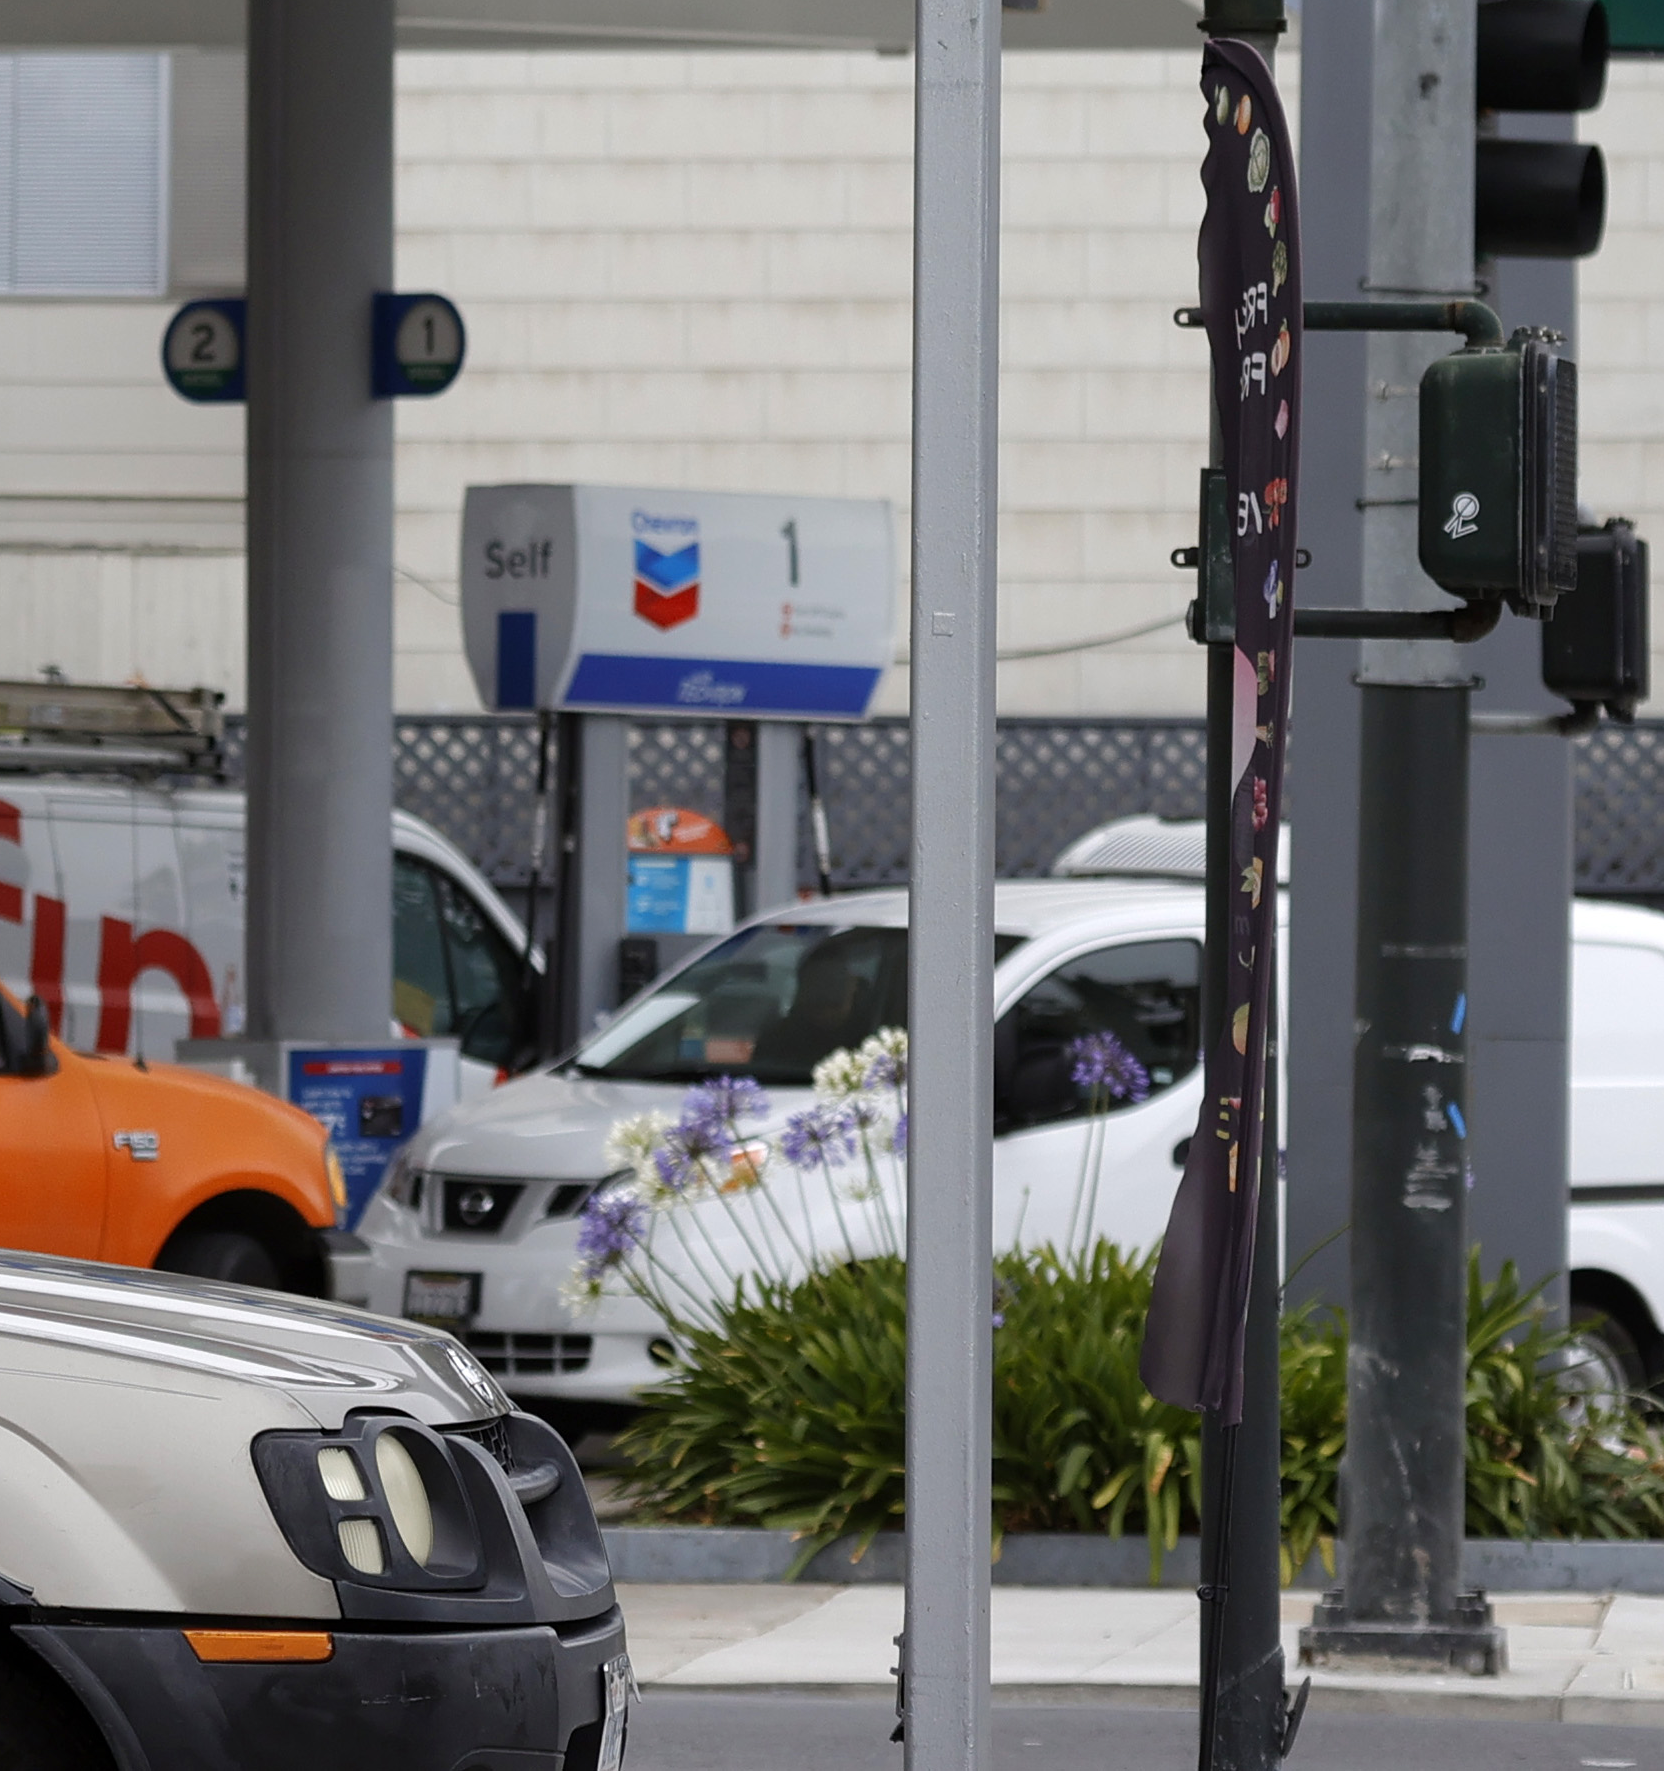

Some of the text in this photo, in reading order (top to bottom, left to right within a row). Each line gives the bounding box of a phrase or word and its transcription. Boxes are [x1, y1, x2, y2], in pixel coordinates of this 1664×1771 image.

[192, 323, 217, 362] 2
[423, 315, 435, 355] 1
[484, 538, 554, 579] Self
[780, 518, 800, 587] 1
